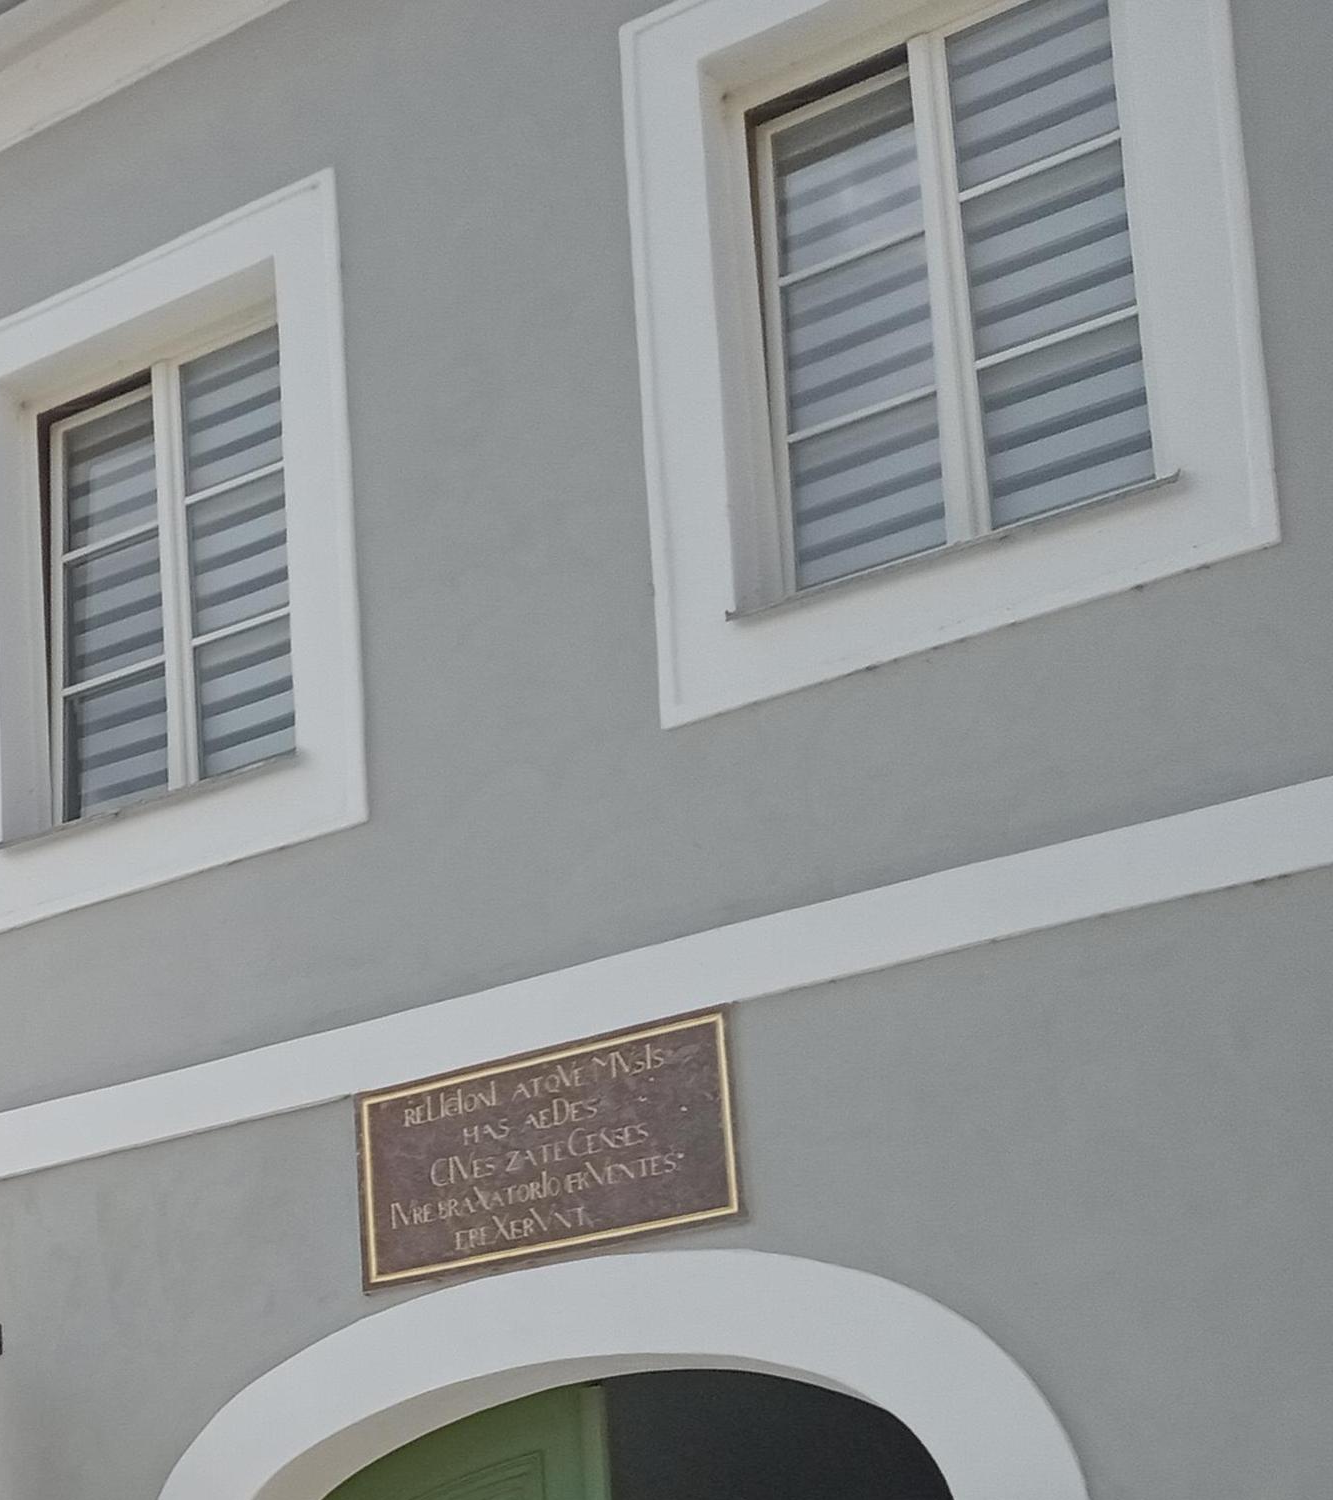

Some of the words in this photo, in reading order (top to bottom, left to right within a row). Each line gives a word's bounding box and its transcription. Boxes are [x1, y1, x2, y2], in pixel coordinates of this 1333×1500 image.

[462, 1118, 511, 1145] HAS
[521, 1097, 598, 1132] AEDES
[430, 1152, 496, 1187] CIVES
